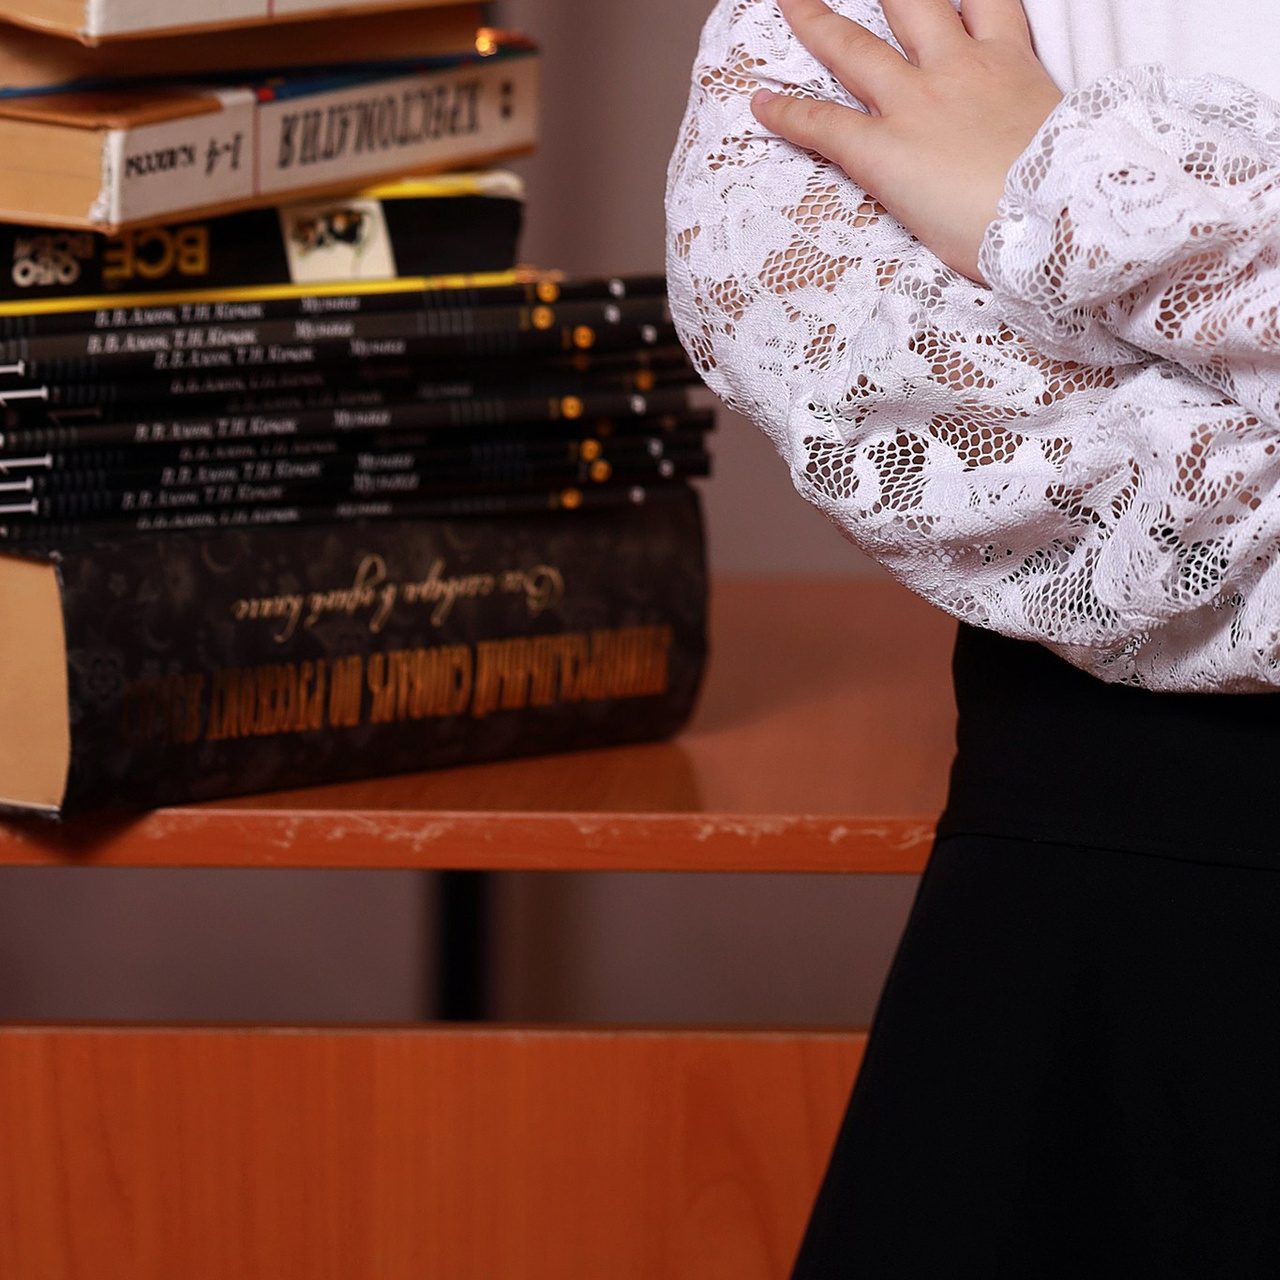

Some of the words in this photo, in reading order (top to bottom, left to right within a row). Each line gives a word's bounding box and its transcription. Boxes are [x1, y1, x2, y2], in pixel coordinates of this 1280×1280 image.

[277, 78, 484, 168] ХРЕСТОМАТИЯ
[123, 144, 198, 178] классы
[205, 132, 242, 175] 1-4
